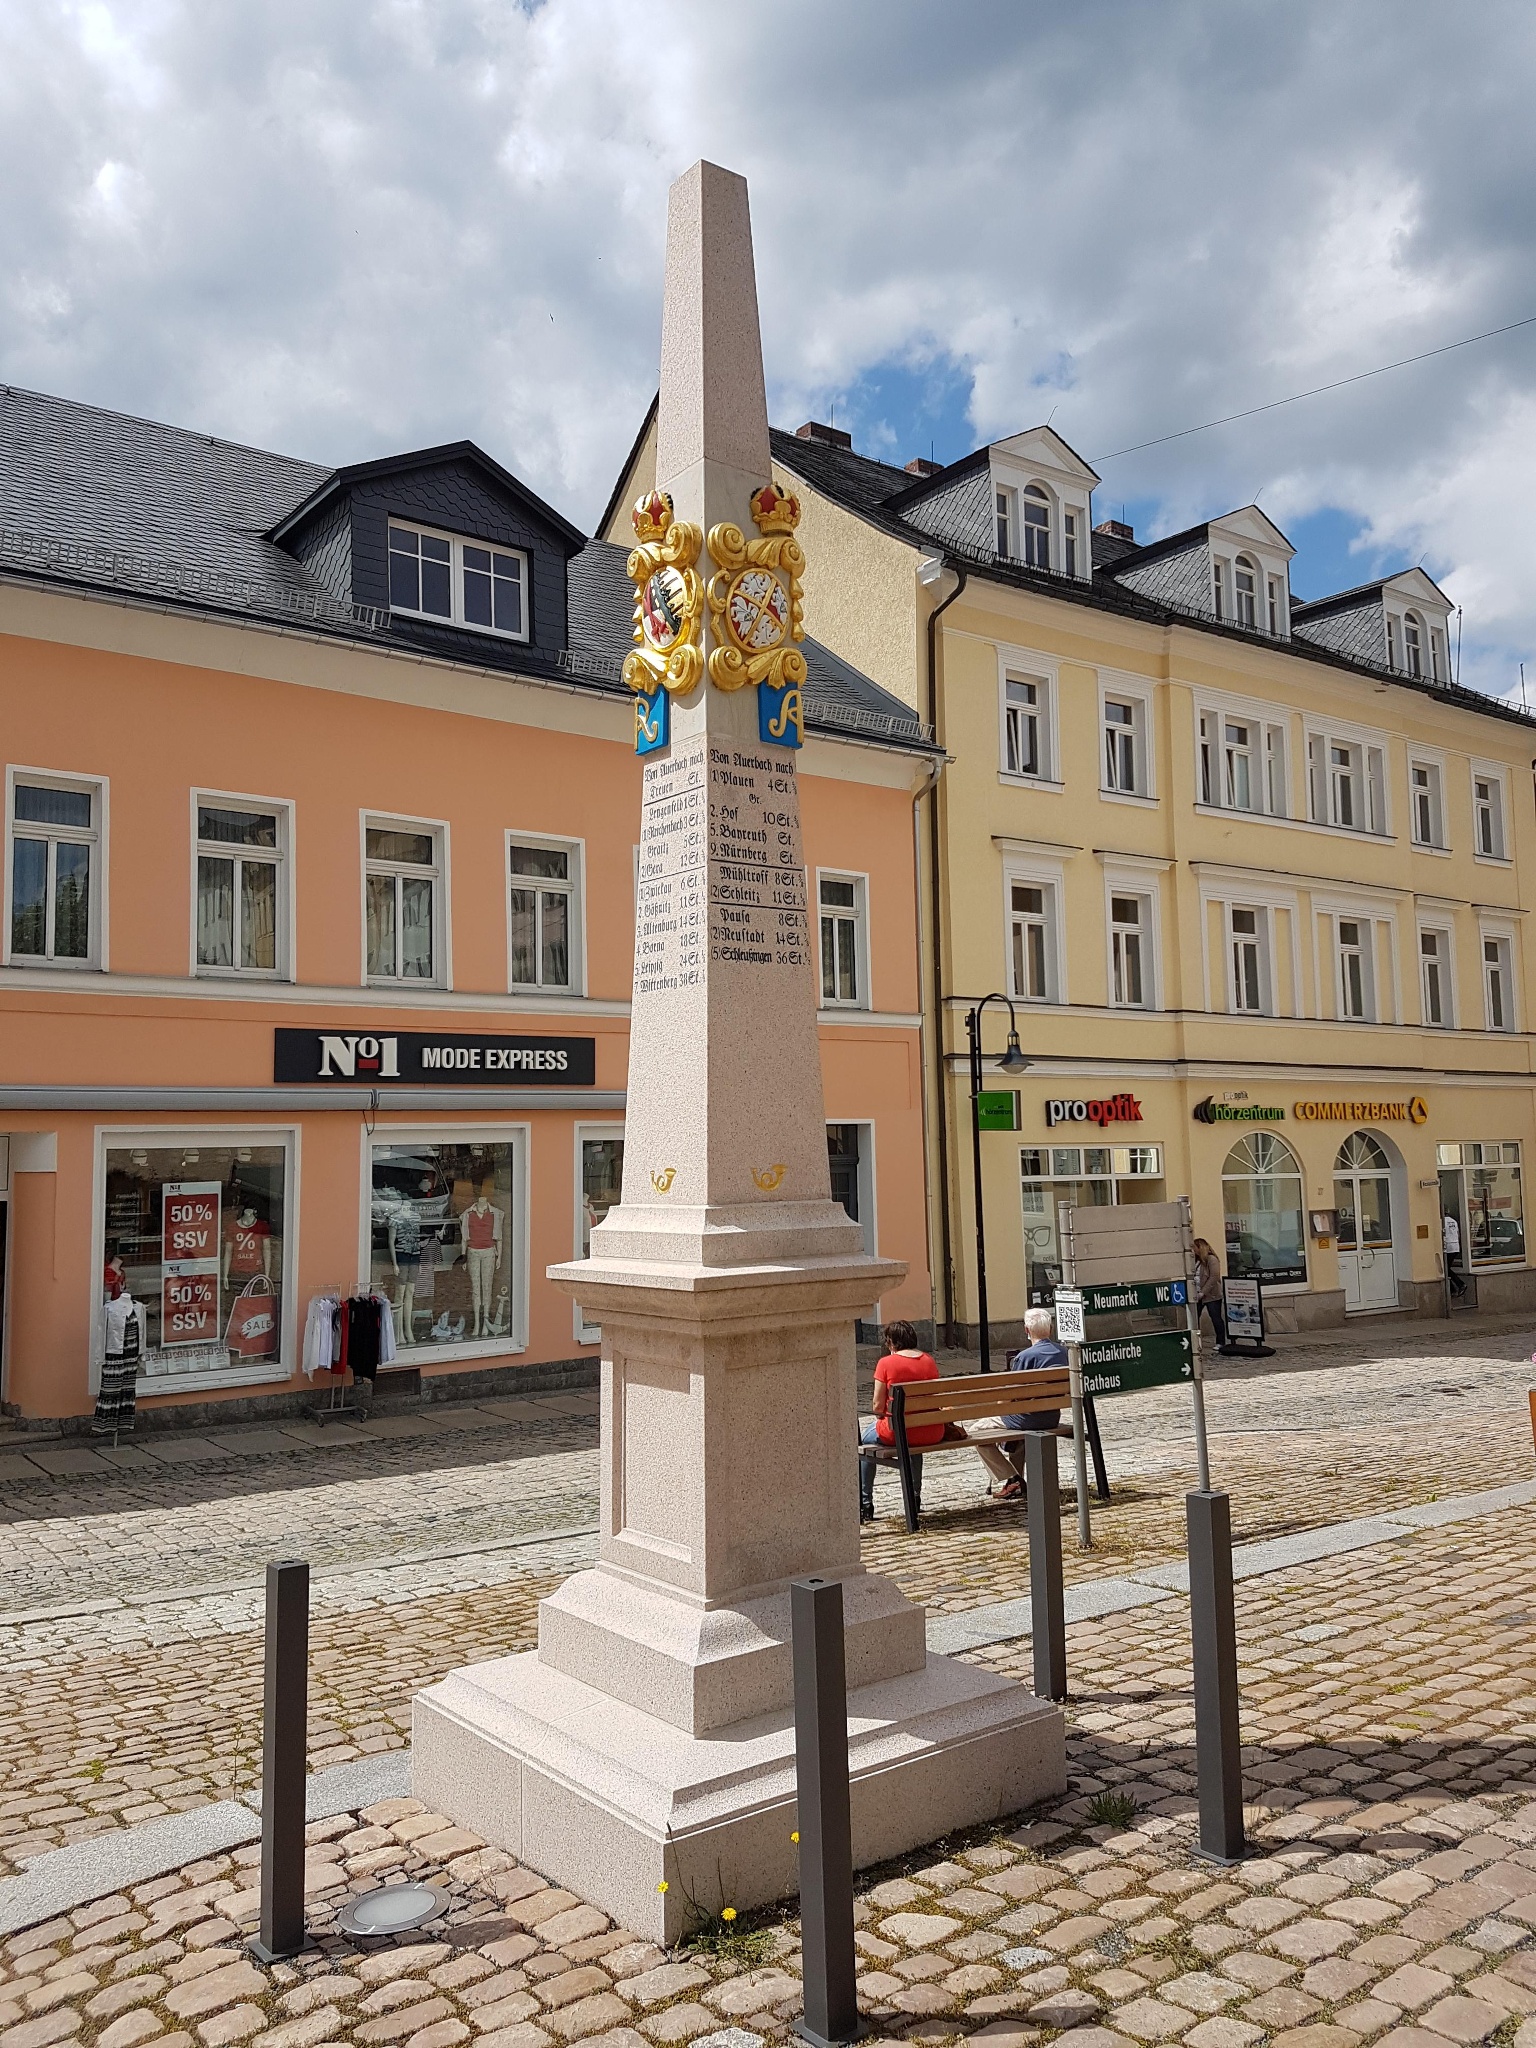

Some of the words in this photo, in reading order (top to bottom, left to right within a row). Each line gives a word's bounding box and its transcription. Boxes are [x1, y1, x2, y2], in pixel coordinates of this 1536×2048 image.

[645, 768, 657, 782] Von
[660, 758, 687, 776] Auerbach
[690, 750, 704, 767] nach
[710, 749, 729, 764] Von
[733, 752, 772, 773] Auerbach
[776, 761, 794, 777] nach
[720, 770, 754, 788] Plauen
[650, 782, 673, 799] Treuen
[720, 824, 767, 845] Bayreuth
[778, 831, 795, 846] St.
[720, 843, 767, 863] Nürnberg
[779, 850, 797, 865] St.
[720, 866, 769, 885] Mühltroff
[720, 885, 760, 904] Schleitz
[643, 919, 678, 936] Altenburg
[640, 975, 678, 993] Wittenberg
[422, 1046, 481, 1070] MODE
[486, 1048, 568, 1071] EXPRESS
[1046, 1093, 1144, 1127] prooptik
[1215, 1104, 1285, 1120] hörzentrum
[1294, 1102, 1407, 1120] COMMERZBANK
[173, 1230, 208, 1249] SSV
[1094, 1290, 1139, 1309] Neumarkt
[1155, 1286, 1170, 1302] WC
[172, 1311, 208, 1331] SSV
[246, 1320, 271, 1330] SALE
[1082, 1343, 1142, 1366] Nicolaikirche
[1083, 1373, 1122, 1394] Rathaus
